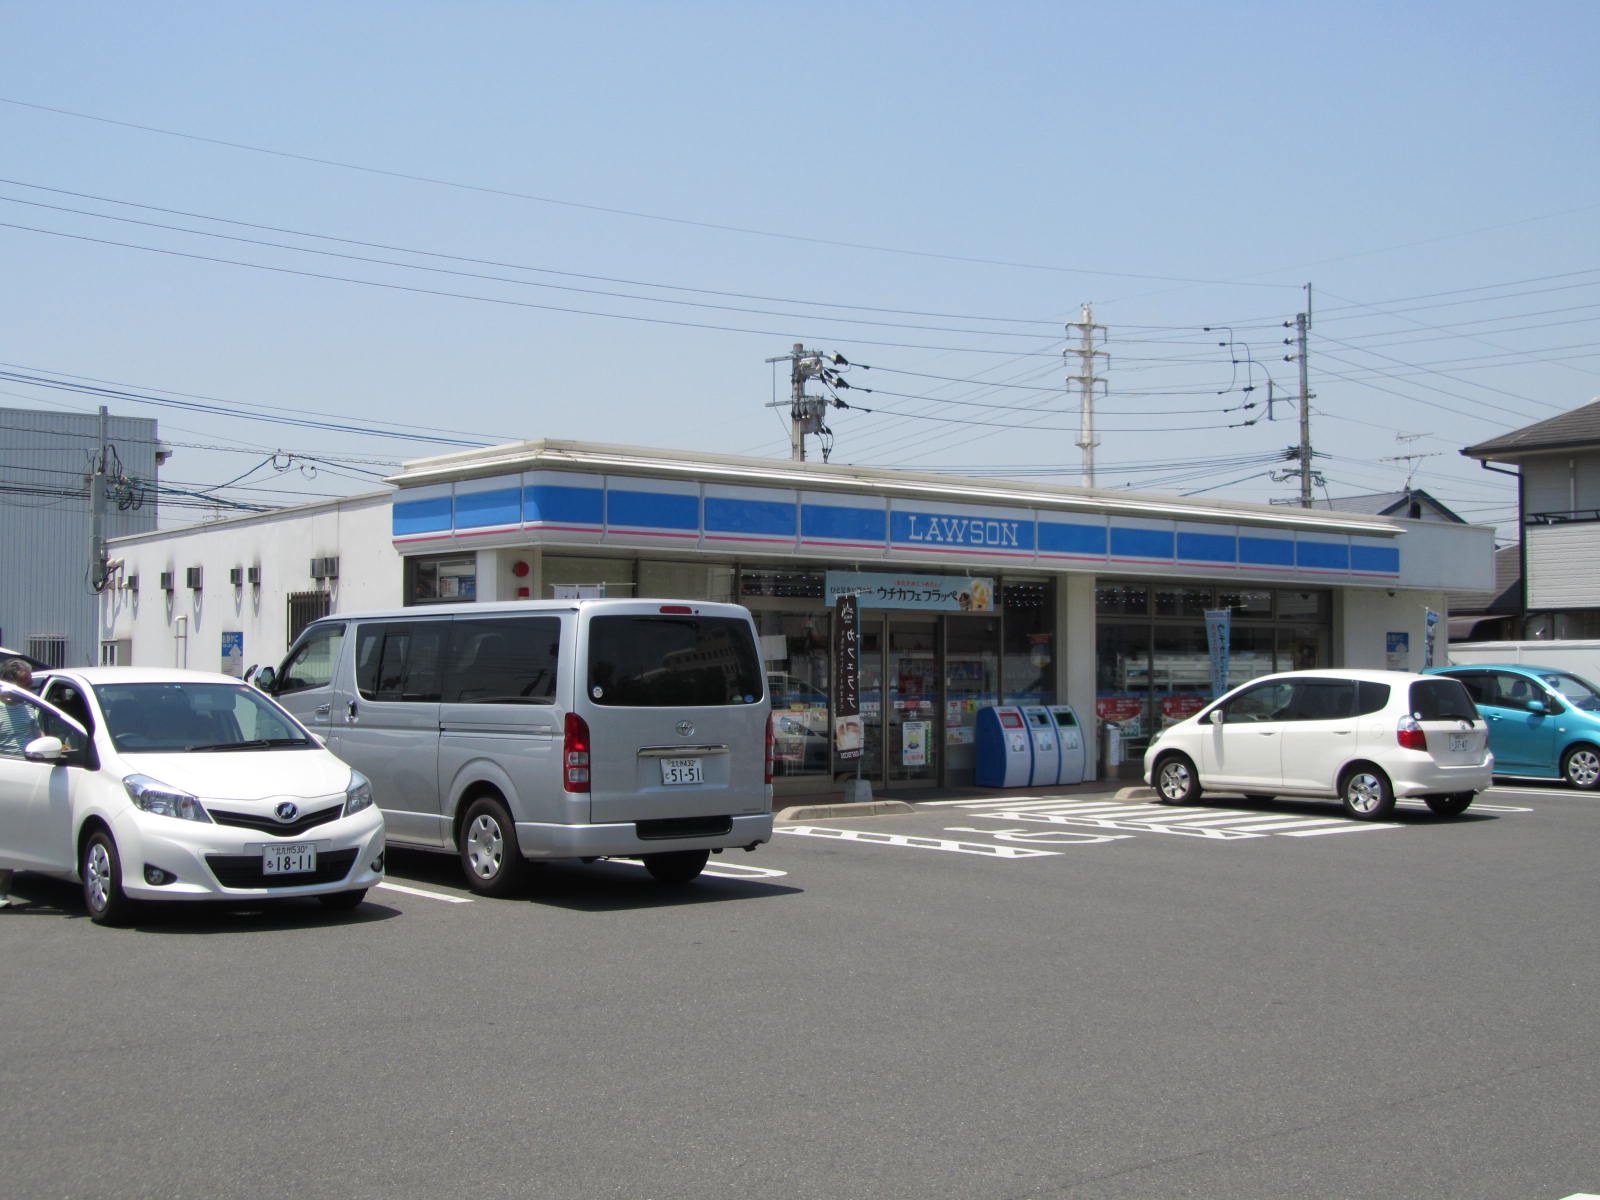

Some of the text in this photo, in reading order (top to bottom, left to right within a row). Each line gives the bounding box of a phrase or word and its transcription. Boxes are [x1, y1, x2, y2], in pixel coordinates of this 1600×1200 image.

[908, 515, 1019, 546] LAWSON
[876, 586, 959, 602] ウチカフェフラッペ
[277, 854, 311, 871] 18-11
